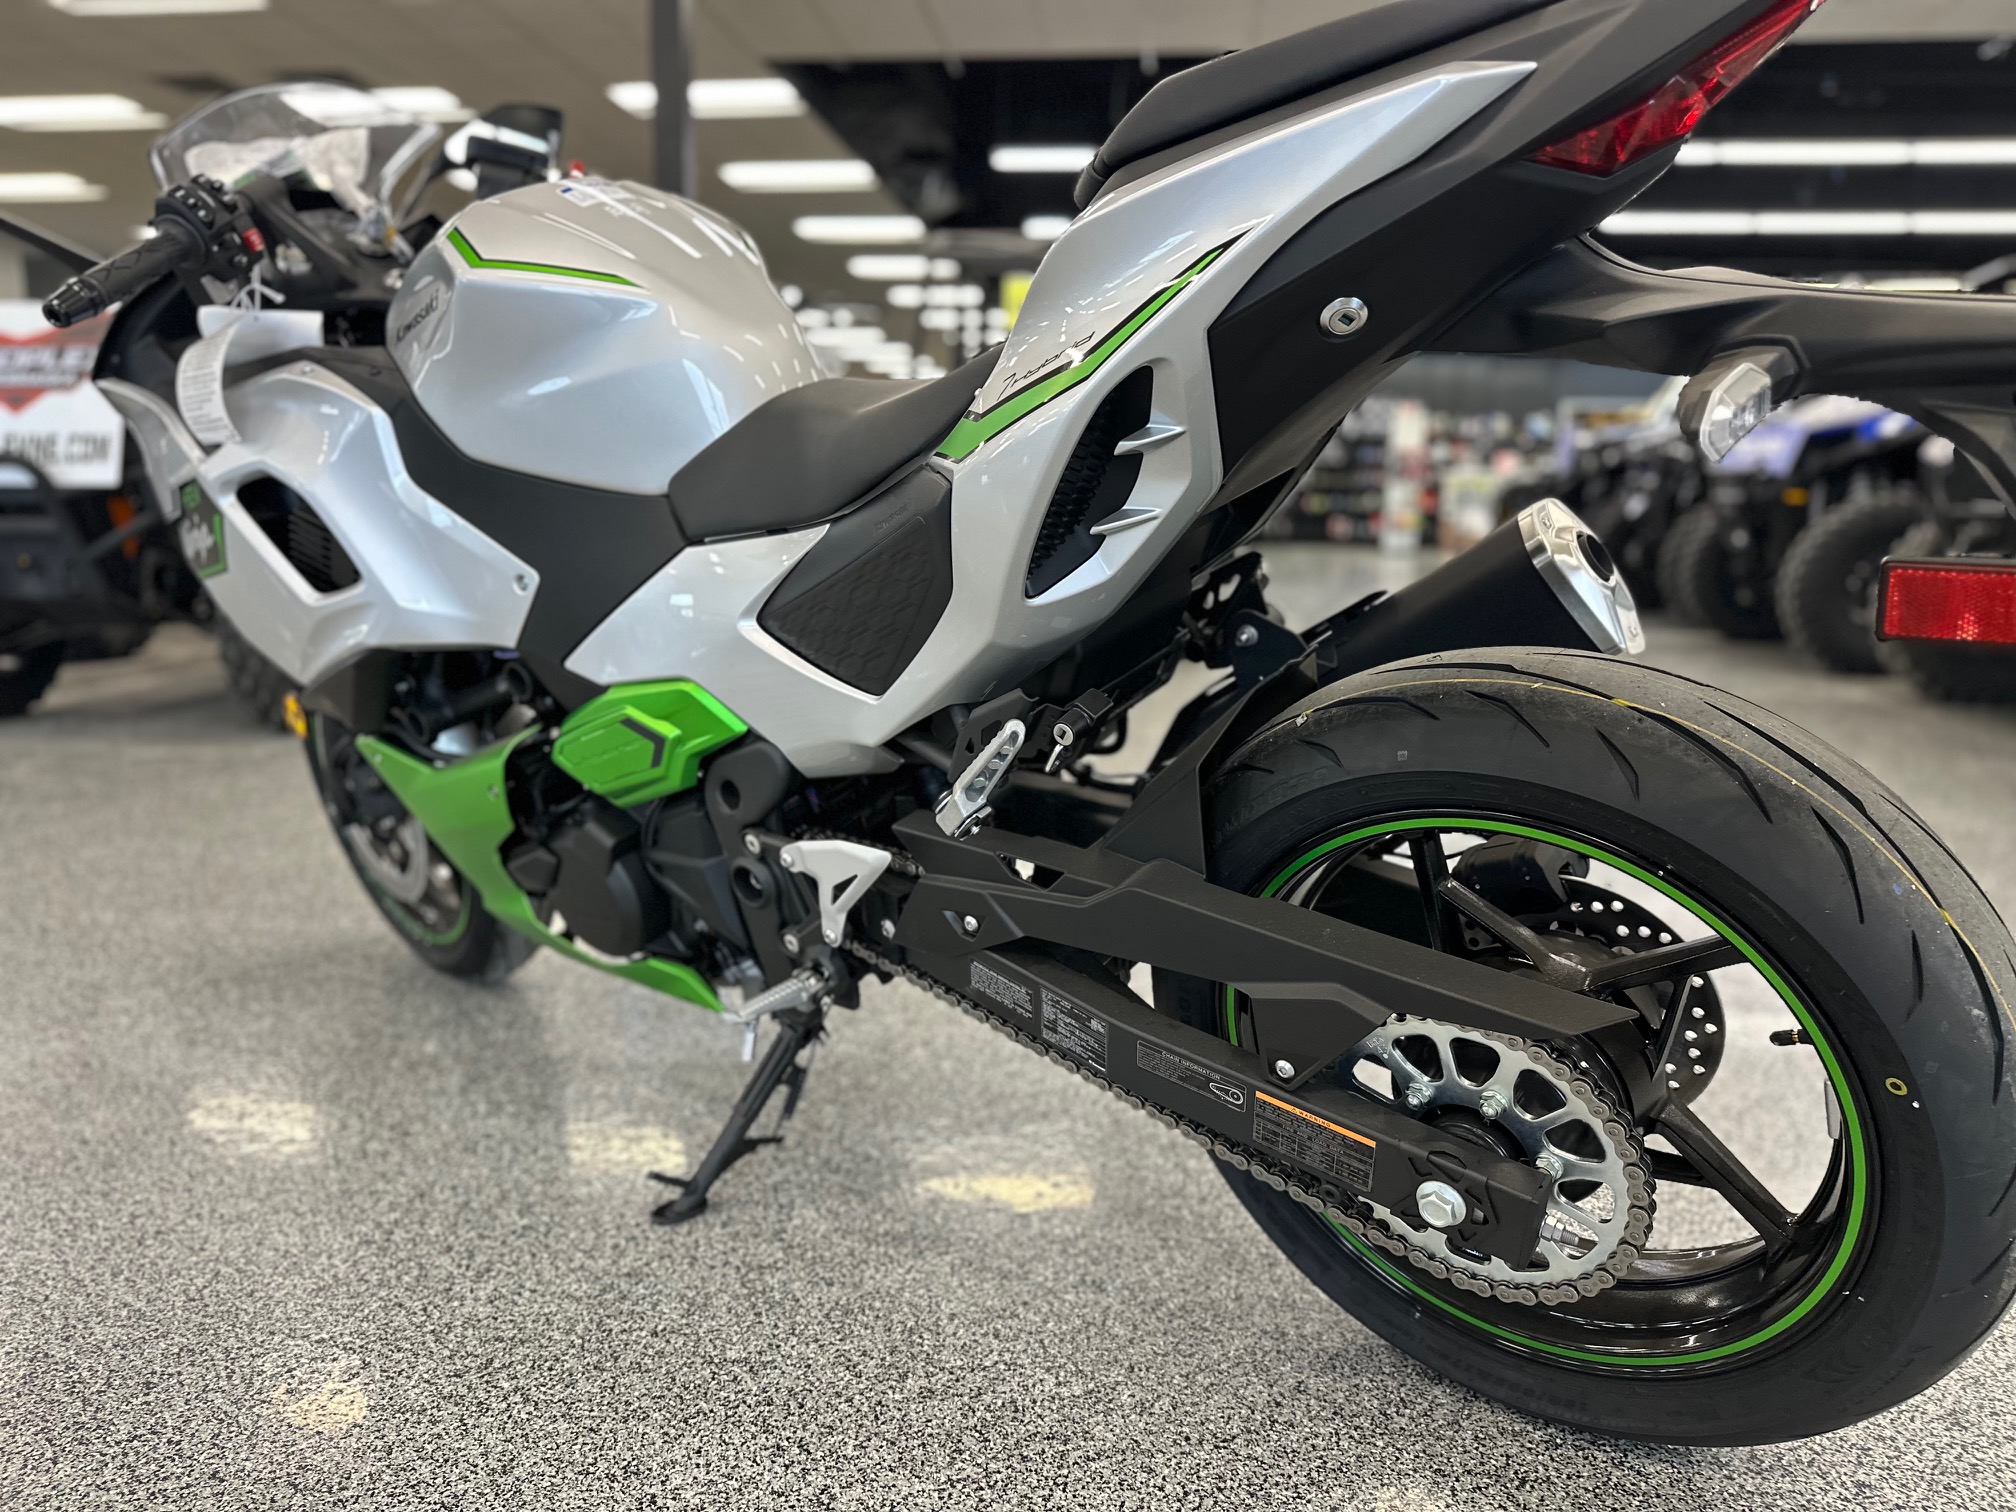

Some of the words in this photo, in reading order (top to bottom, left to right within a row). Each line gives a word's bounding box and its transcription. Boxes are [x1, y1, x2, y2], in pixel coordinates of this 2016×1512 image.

[1161, 1050, 1180, 1063] CHAIN
[1180, 1058, 1221, 1080] INFORMATION
[1298, 1110, 1332, 1128] WARNING
